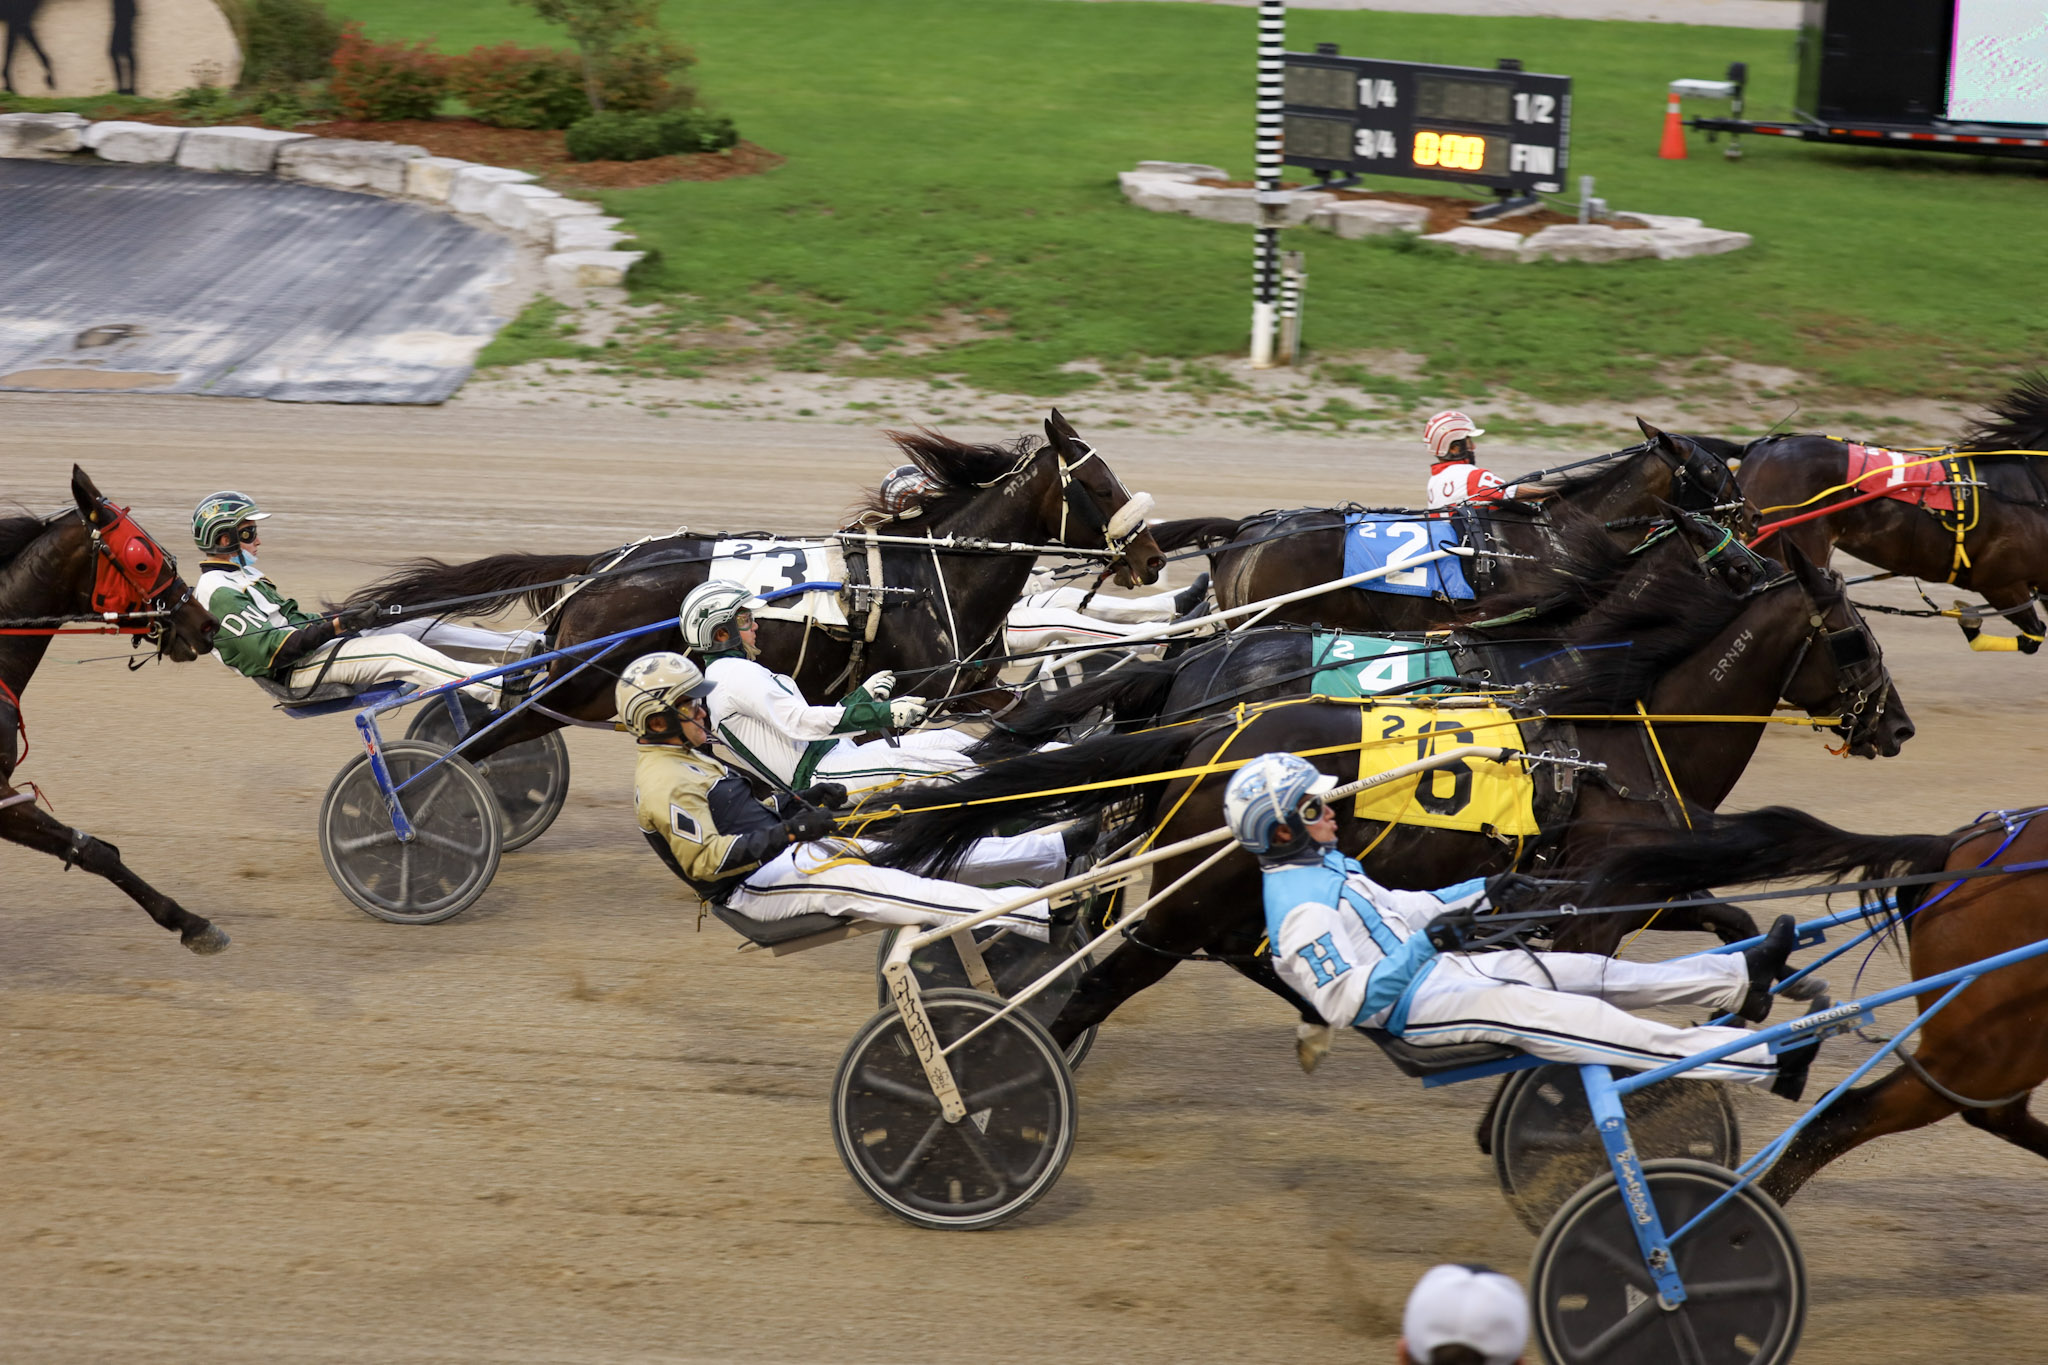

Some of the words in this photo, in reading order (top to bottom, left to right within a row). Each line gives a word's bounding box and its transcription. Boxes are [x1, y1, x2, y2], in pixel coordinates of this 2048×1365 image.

[1357, 77, 1397, 109] 1/4
[1513, 92, 1555, 124] 1/2
[1354, 128, 1397, 159] 3/4
[732, 543, 753, 560] 2
[760, 546, 808, 610] 3
[1358, 520, 1377, 539] 2
[1385, 521, 1429, 587] 2
[220, 604, 269, 637] DN
[1332, 639, 1355, 660] 2
[1357, 645, 1414, 701] 4
[1382, 714, 1405, 744] 2
[1414, 720, 1474, 816] 6
[1295, 931, 1353, 990] H
[1790, 1004, 1861, 1031] NITROUS
